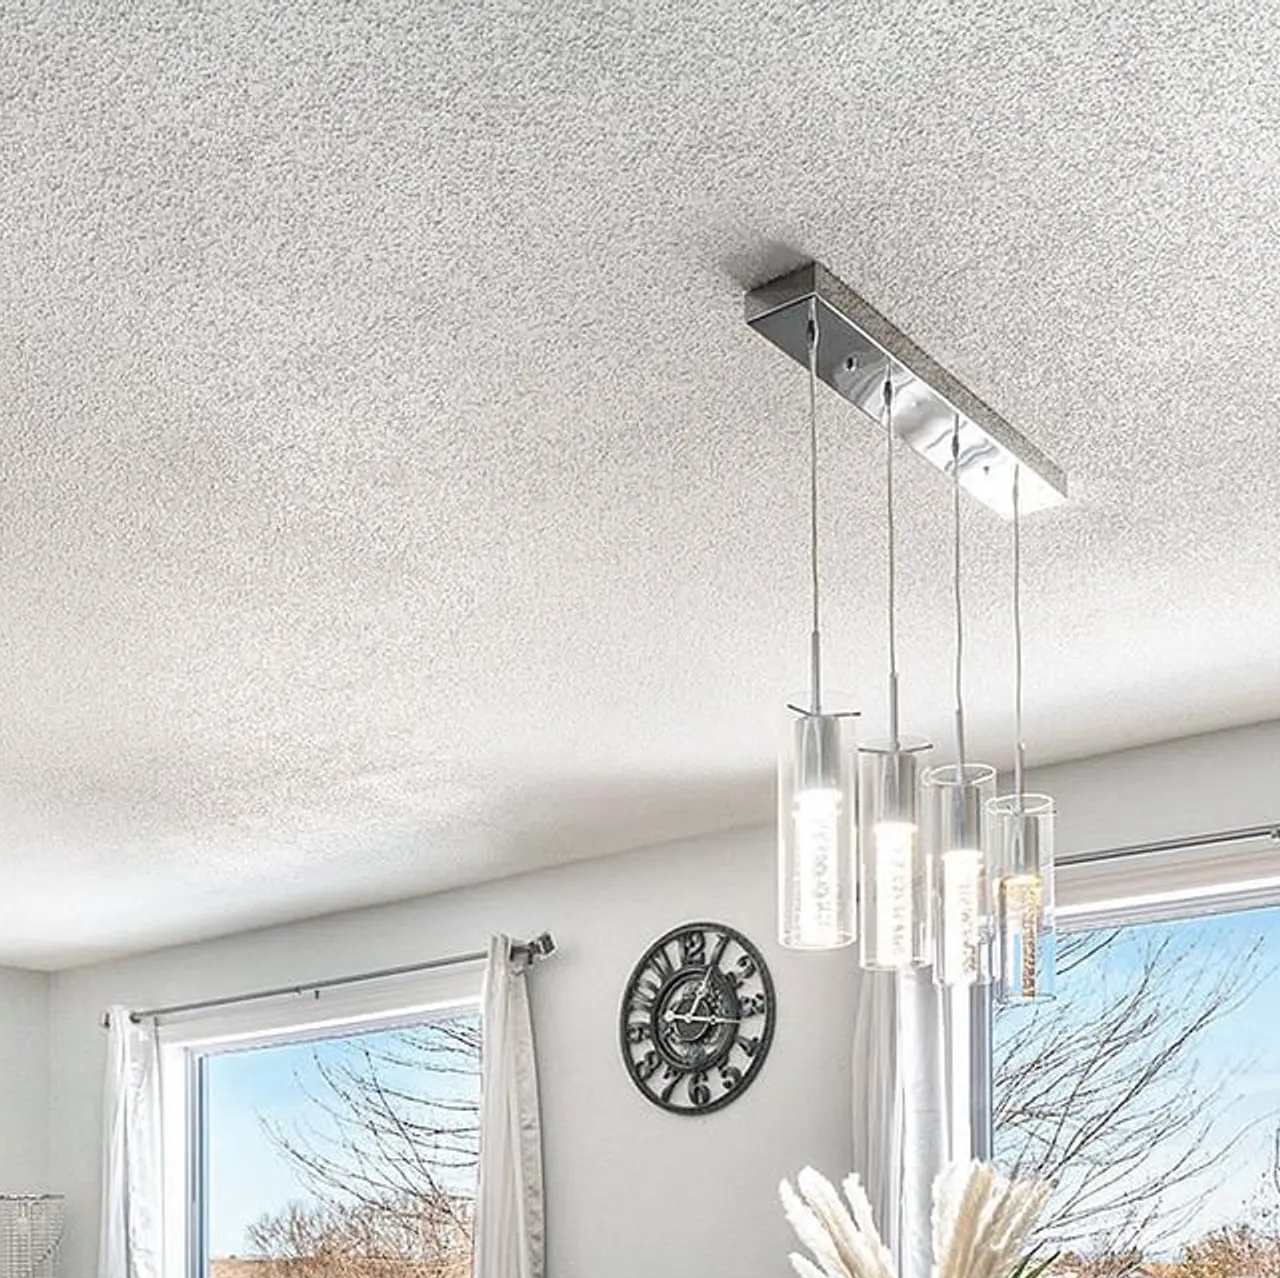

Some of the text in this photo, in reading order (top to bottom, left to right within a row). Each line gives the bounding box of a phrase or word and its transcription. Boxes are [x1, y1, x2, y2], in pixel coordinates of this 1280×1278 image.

[710, 932, 729, 966] 1
[636, 1051, 661, 1081] 8
[661, 1065, 686, 1103] 7
[688, 1072, 711, 1105] 6
